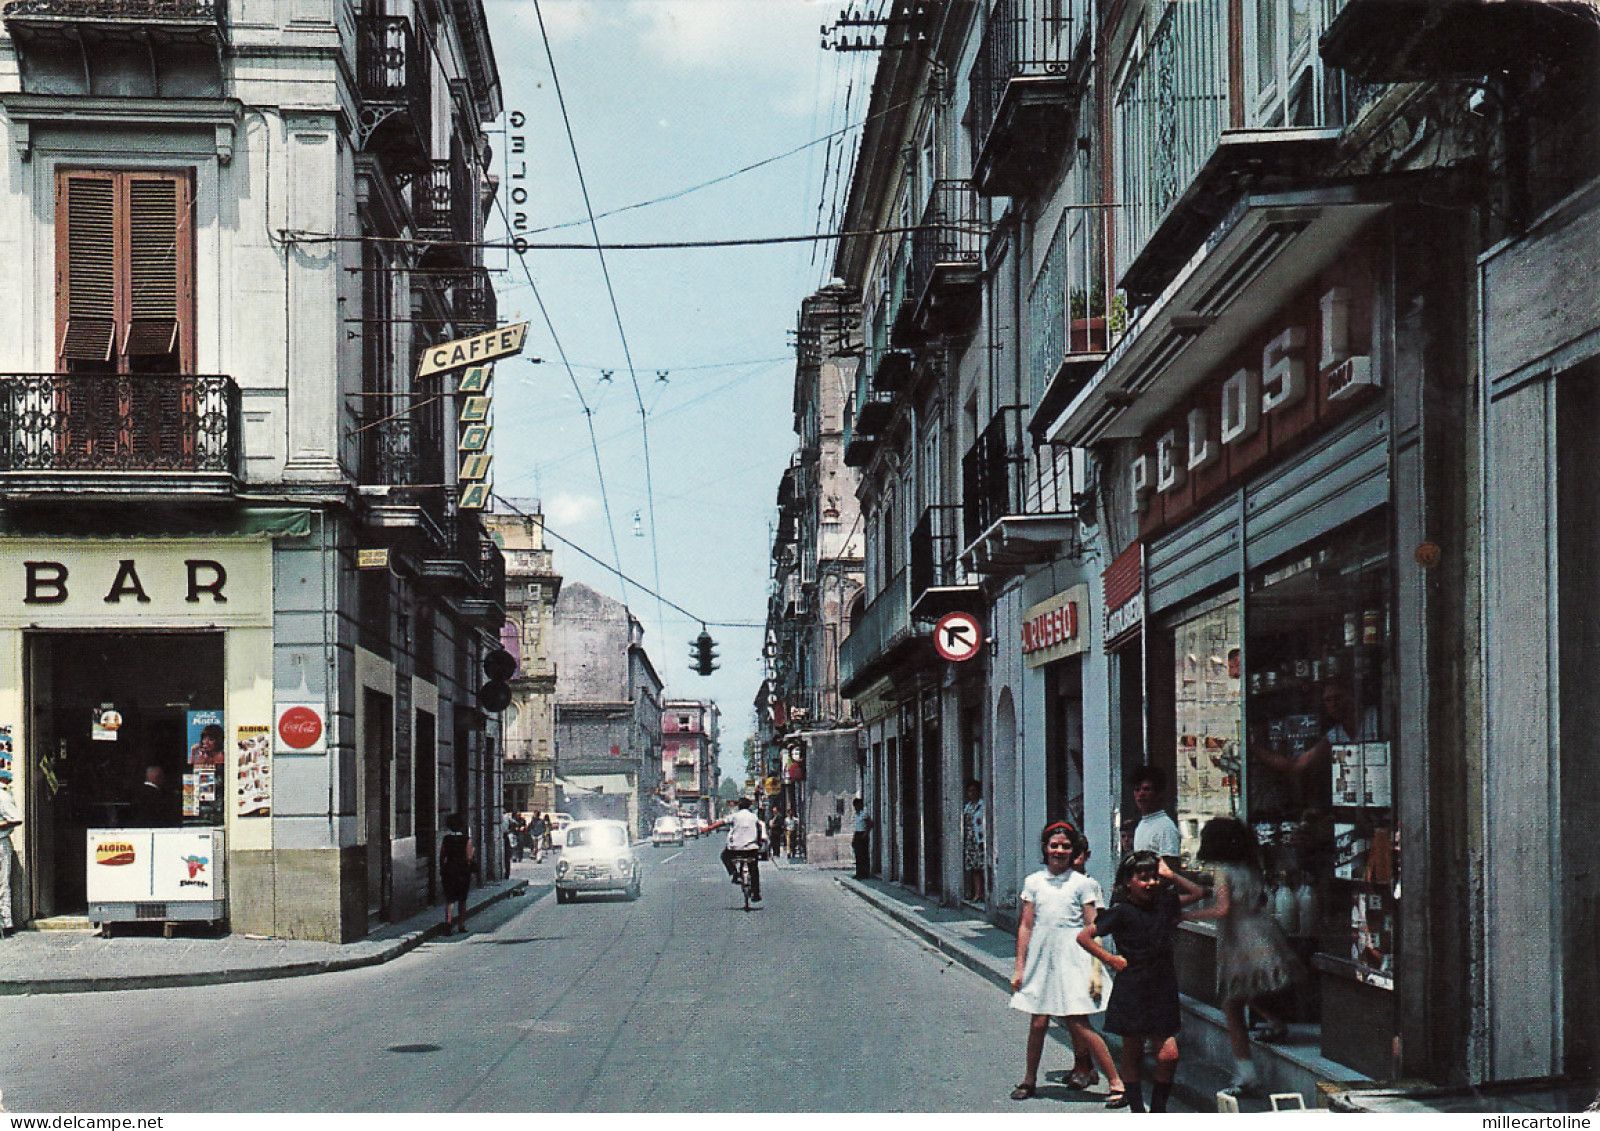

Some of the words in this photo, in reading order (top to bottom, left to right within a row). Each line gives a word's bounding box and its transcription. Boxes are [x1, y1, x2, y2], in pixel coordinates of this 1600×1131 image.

[509, 110, 528, 254] GELOSO
[462, 368, 486, 507] ALOIA
[1131, 288, 1340, 514] PELOSI
[23, 559, 228, 603] BAR
[96, 844, 134, 853] ALGIDA
